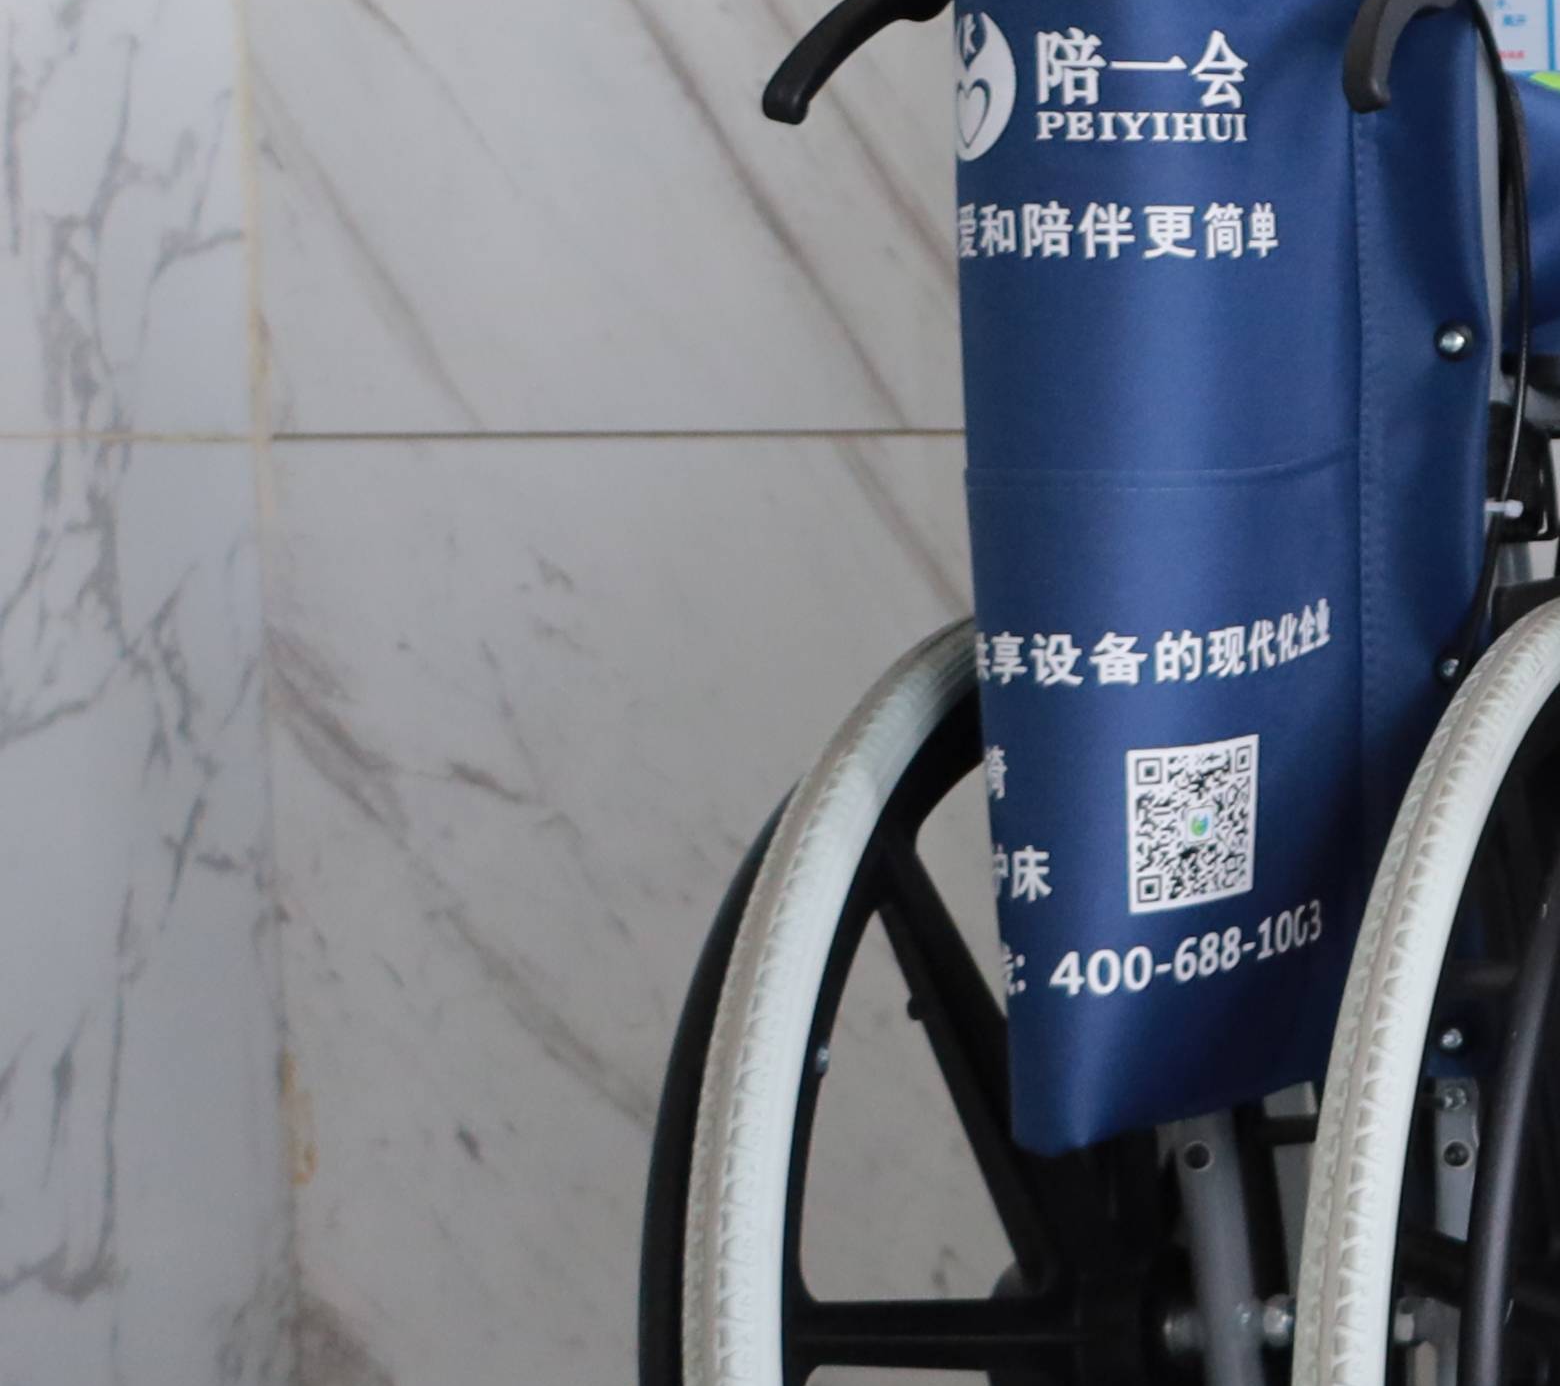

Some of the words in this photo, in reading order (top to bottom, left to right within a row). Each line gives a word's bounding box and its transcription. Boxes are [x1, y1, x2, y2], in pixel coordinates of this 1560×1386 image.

[1036, 26, 1249, 109] 陪一会
[1035, 111, 1249, 142] PEIYIHUI
